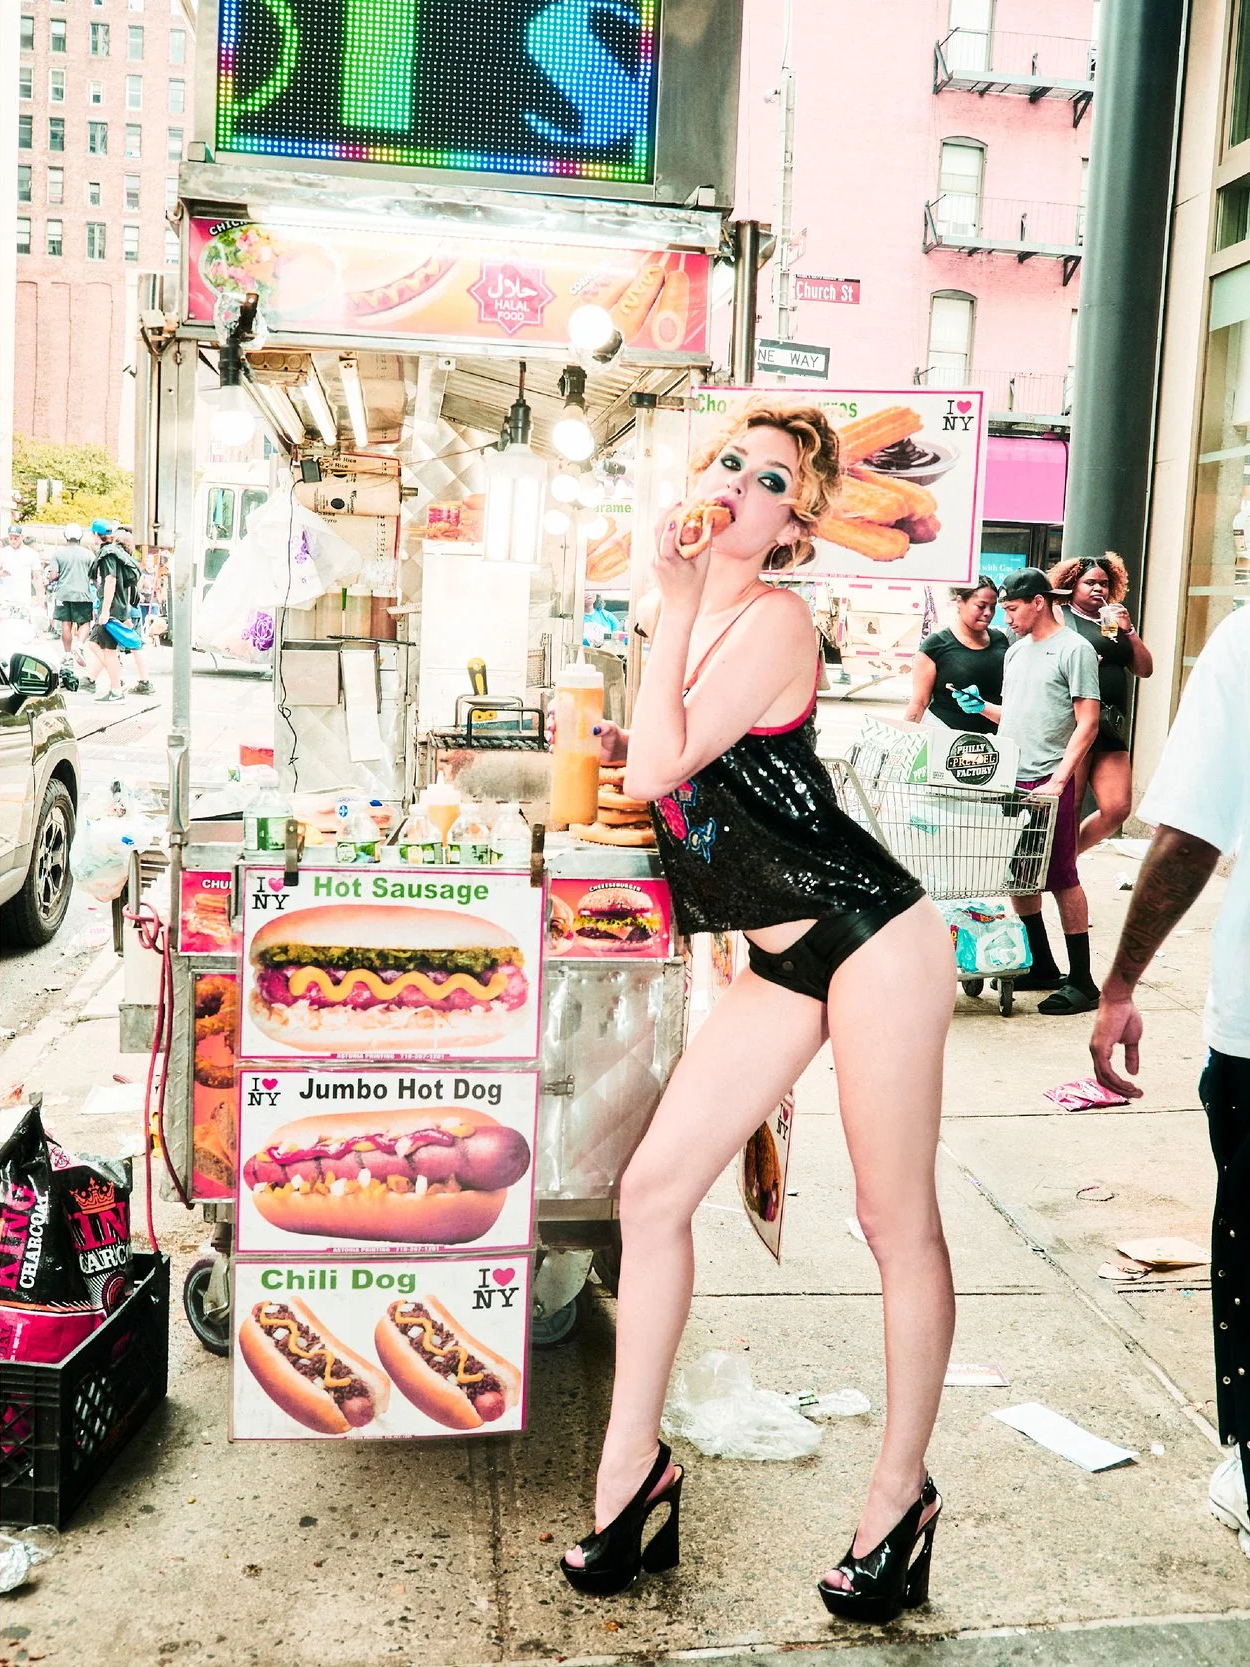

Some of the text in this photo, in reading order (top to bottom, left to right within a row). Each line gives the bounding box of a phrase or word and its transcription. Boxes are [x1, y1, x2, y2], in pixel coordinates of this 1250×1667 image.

[487, 273, 538, 299] حلال
[796, 281, 853, 302] Church St
[494, 300, 530, 312] HALAL
[497, 311, 524, 321] FOOD
[754, 348, 819, 368] NE WAY
[946, 400, 955, 415] I
[942, 416, 974, 431] NY
[957, 743, 986, 754] PHILLY
[956, 766, 993, 778] FACTORY
[256, 877, 266, 892] I
[313, 876, 489, 905] Hot Sausage
[589, 882, 642, 893] CHEESEBURGER
[252, 894, 290, 910] NY
[251, 1077, 260, 1091] I
[247, 1092, 281, 1106] NY
[299, 1078, 502, 1106] Jumbo Hot Dog
[19, 1191, 49, 1289] CHARCOAL
[261, 1269, 417, 1294] Chili Dog
[478, 1268, 491, 1288] I
[472, 1287, 519, 1309] NY
